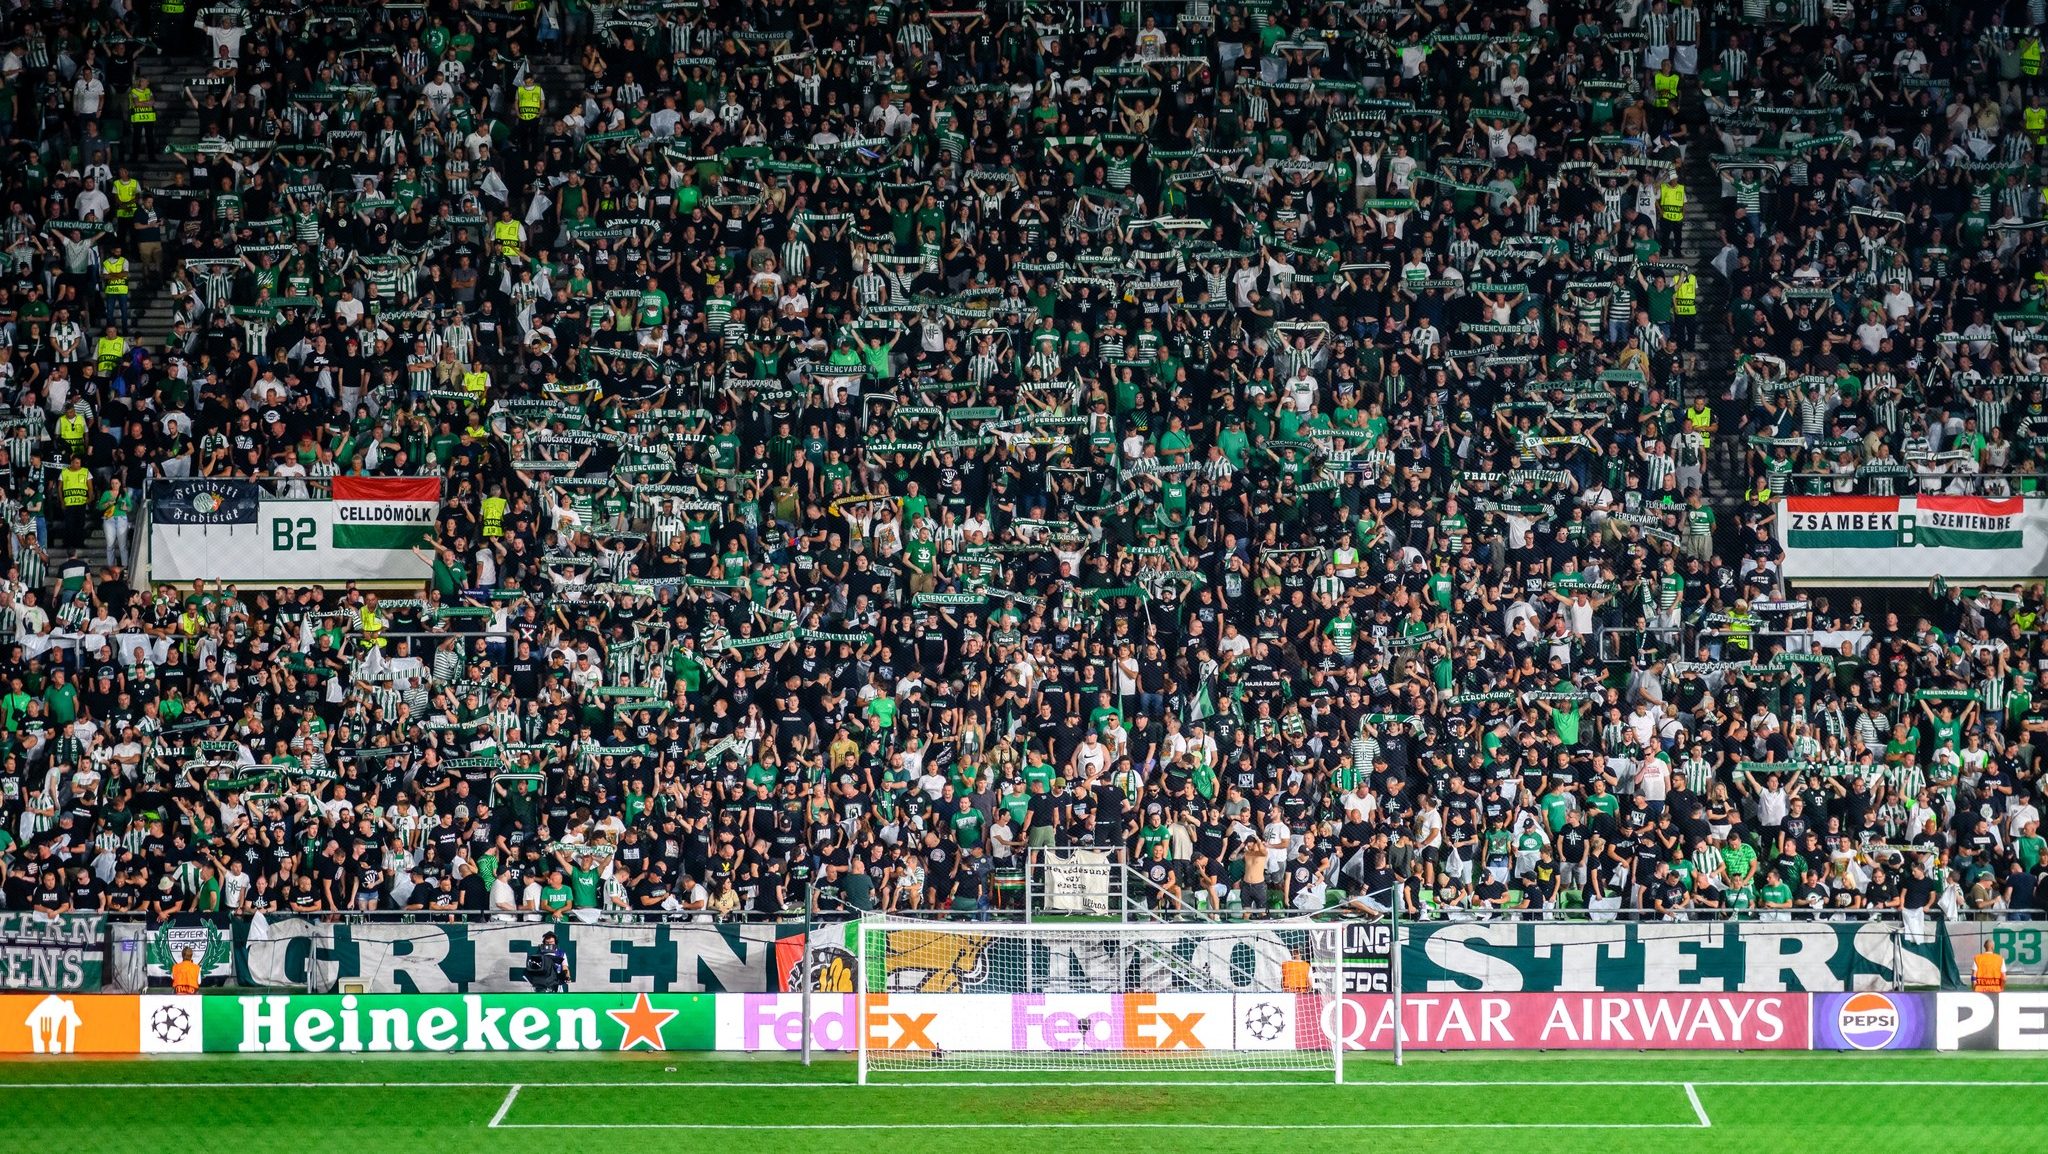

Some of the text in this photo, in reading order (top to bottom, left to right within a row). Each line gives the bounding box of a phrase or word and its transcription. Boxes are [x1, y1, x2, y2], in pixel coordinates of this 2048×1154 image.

[1350, 129, 1381, 138] 1899
[1640, 197, 1651, 207] 33
[1470, 324, 1522, 333] FERENCVAROS
[816, 365, 867, 373] FERENCVAROS
[760, 390, 794, 401] 1899
[669, 433, 706, 443] FRADI
[620, 464, 670, 473] FERENCVAROS
[1861, 465, 1908, 474] FERENCVAROS
[553, 476, 607, 485] FERENCVAROS
[1463, 472, 1501, 481] FRADI
[340, 504, 432, 523] CELLDÖMÖLK
[1792, 512, 1894, 531] ZSÁMBÉK
[1931, 512, 2012, 530] SZENTENDRE
[272, 517, 317, 551] B2
[548, 894, 568, 902] FRADI
[168, 929, 208, 940] EASTERN
[246, 915, 777, 993] GREEN
[238, 995, 602, 1052] Heineken
[743, 993, 938, 1050] FedEx
[1011, 993, 1206, 1049] FedEx
[1320, 998, 1784, 1051] QATAR AIRWAYS
[1842, 1015, 1896, 1027] PEPSI
